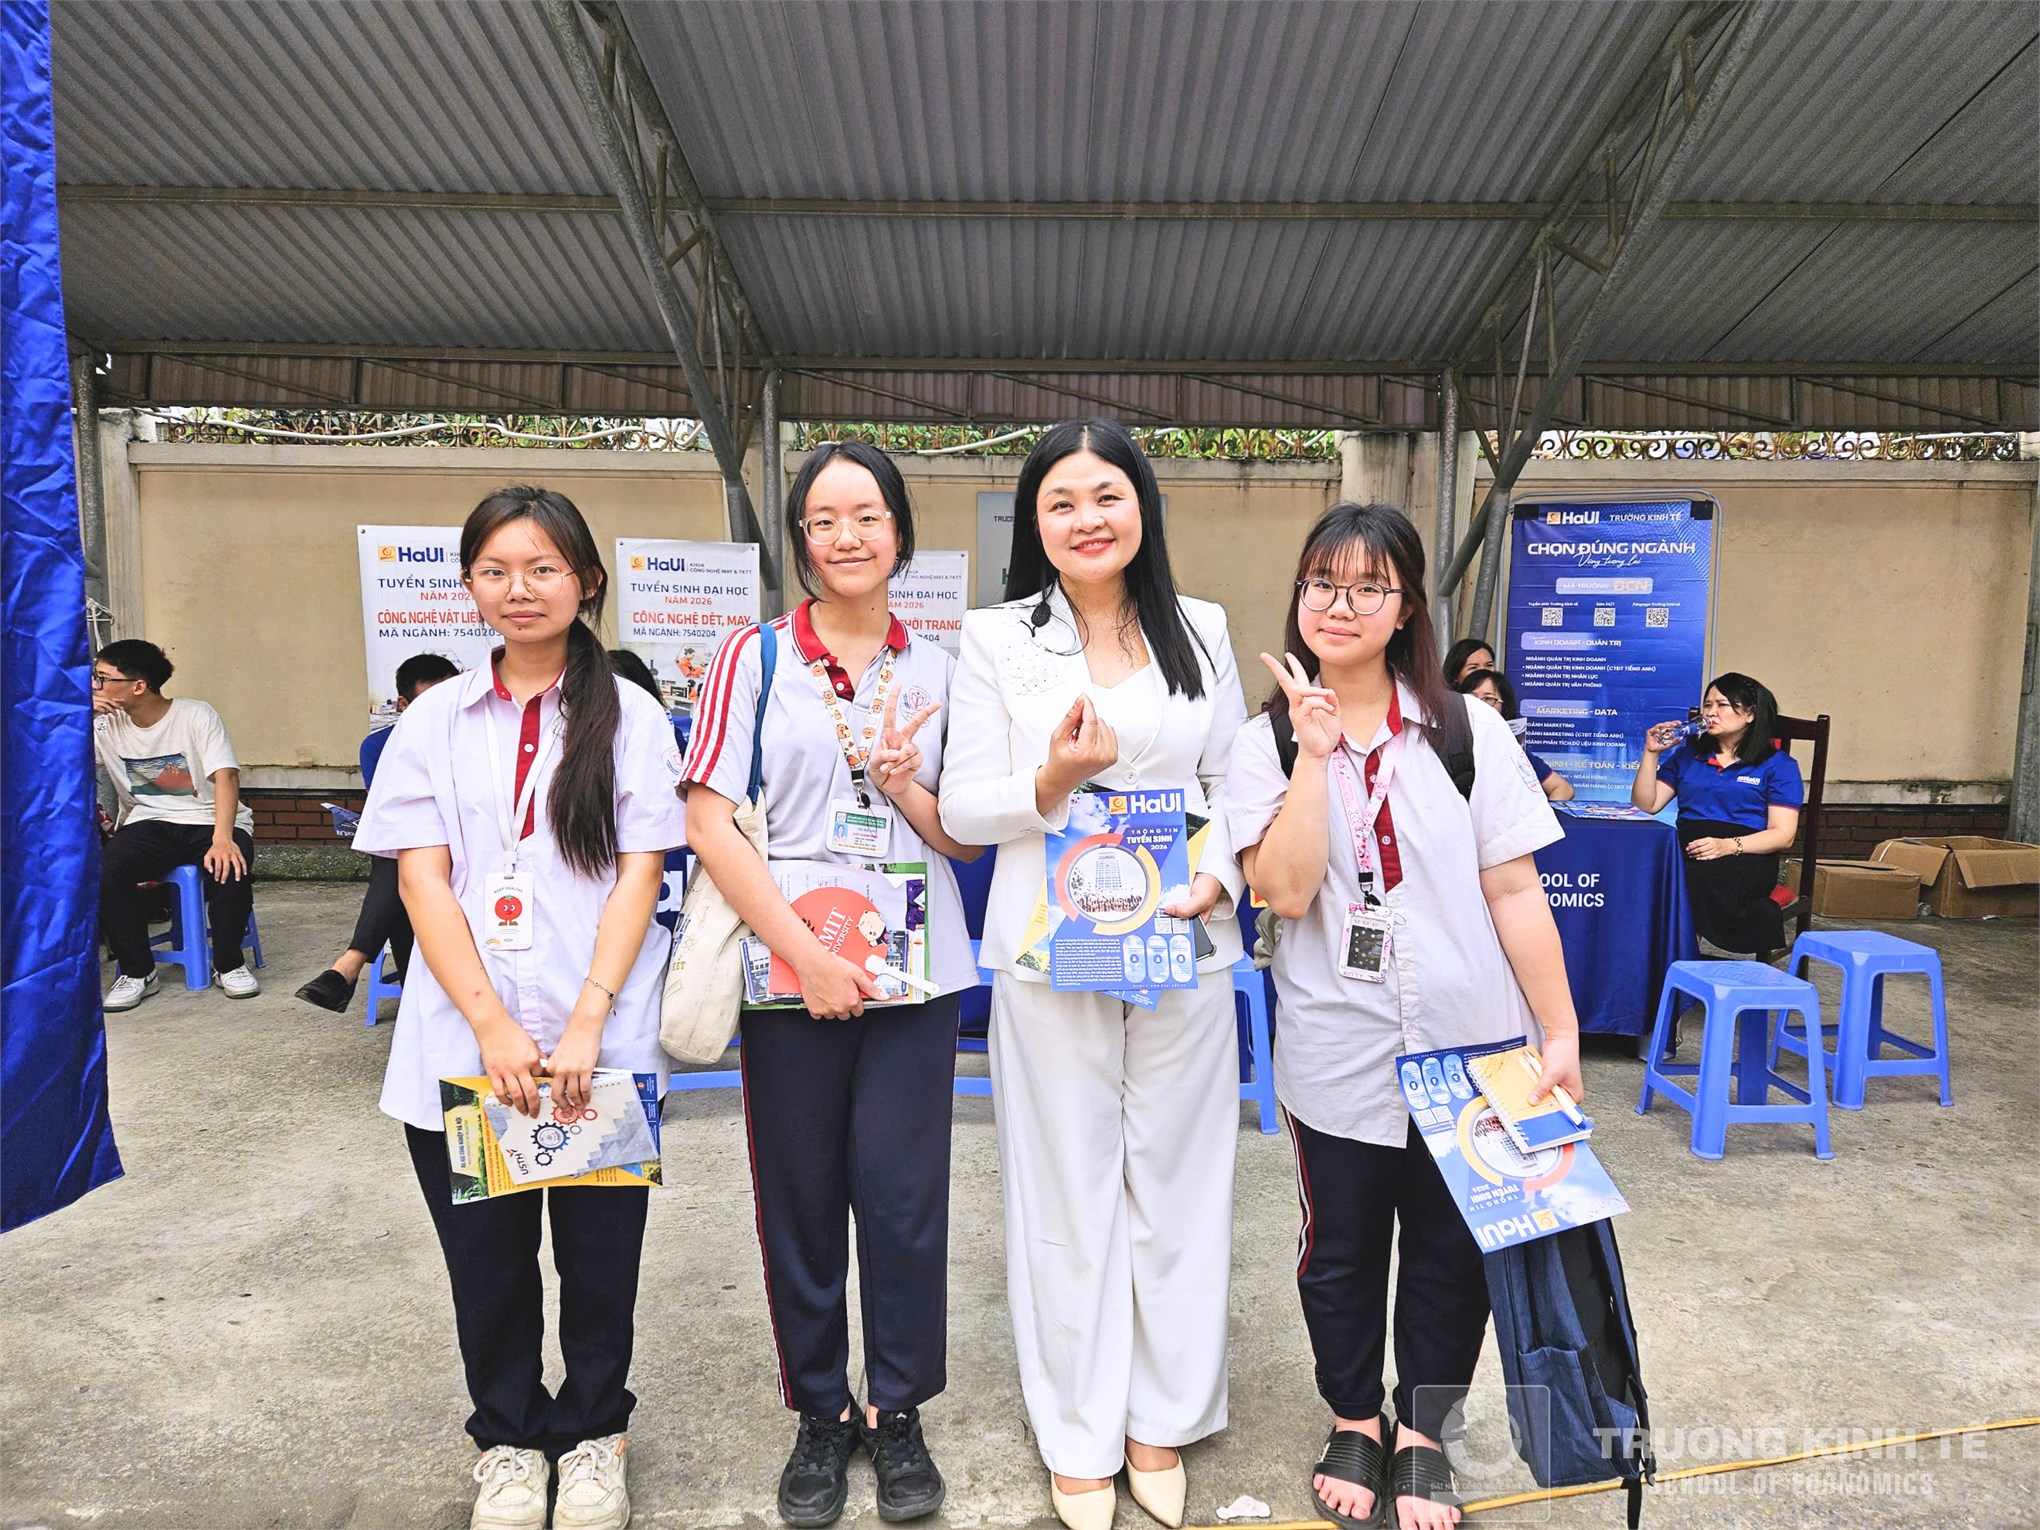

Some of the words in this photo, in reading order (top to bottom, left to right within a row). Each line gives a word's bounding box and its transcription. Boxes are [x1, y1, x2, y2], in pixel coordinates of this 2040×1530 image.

[1562, 511, 1599, 524] HaUI
[1609, 512, 1646, 522] TRƯỜNG
[1647, 513, 1668, 521] KINH
[1669, 511, 1683, 521] TẾ
[398, 547, 444, 563] HaUI
[1527, 543, 1575, 556] CHỌN
[1577, 539, 1629, 555] ĐÚNG
[1631, 539, 1696, 554] NGÀNH
[647, 557, 685, 572] HaUI
[377, 574, 425, 588] TUYỂN
[429, 579, 462, 588] SINH
[420, 591, 448, 600] NĂM
[451, 592, 474, 601] 202
[630, 580, 669, 593] TUYỂN
[672, 584, 700, 594] SINH
[703, 585, 723, 597] ĐẠI
[726, 586, 749, 598] HỌC
[888, 590, 913, 599] SINH
[916, 591, 934, 600] ĐẠI
[937, 591, 958, 600] HỌC
[665, 596, 687, 604] NĂM
[690, 597, 713, 605] 2026
[377, 609, 407, 624] CÔNG
[409, 609, 437, 626] NGHỆ
[439, 609, 459, 626] VẬT
[632, 610, 664, 624] CÔNG
[667, 612, 699, 628] NGHỆ
[701, 612, 725, 628] DỆT,
[727, 615, 751, 626] MAY
[925, 620, 962, 630] TRANG
[379, 627, 399, 637] MÃ
[402, 626, 450, 638] NGÀNH:
[453, 628, 501, 637] 754020
[633, 627, 647, 636] MÃ
[649, 627, 681, 637] NGÀNH:
[682, 628, 716, 637] 7540204
[1536, 707, 1588, 715] MARKETING
[1589, 760, 1615, 769] TOÁN
[1130, 792, 1182, 814] HaUI
[1126, 833, 1152, 844] TUYỂN
[1152, 835, 1173, 843] SINH
[1539, 873, 1573, 888] OOL
[1577, 873, 1600, 888] OF
[1545, 892, 1605, 908] OMICS
[818, 906, 847, 950] MIT
[831, 916, 853, 956] NIVERSITY
[515, 1153, 529, 1176] USTH
[1475, 1214, 1537, 1249] HaUI
